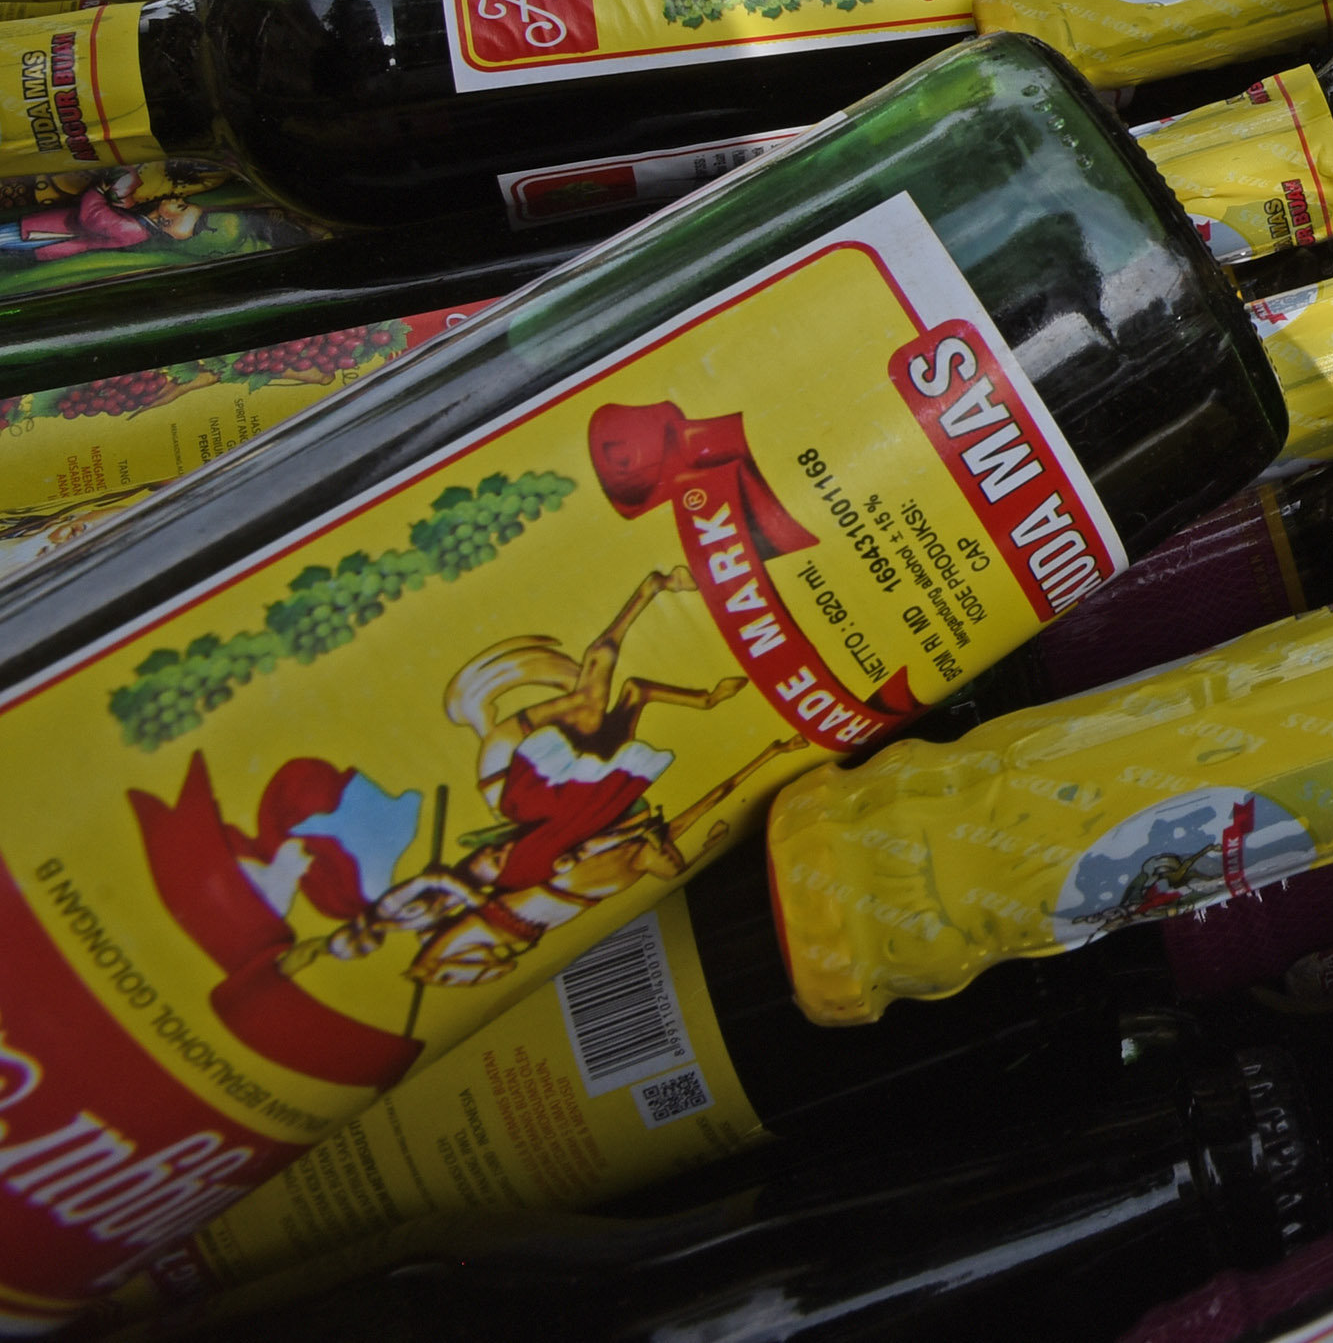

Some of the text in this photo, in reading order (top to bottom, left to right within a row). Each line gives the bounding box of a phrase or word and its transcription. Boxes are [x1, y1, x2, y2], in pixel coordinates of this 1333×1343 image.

[51, 31, 77, 88] BUAH
[22, 49, 63, 153] KUDA MAS
[1264, 197, 1291, 241] MAS
[1281, 179, 1315, 229] BUAH
[907, 336, 1045, 505] MAS
[56, 473, 70, 499] ANAK
[796, 446, 903, 594] 169431001168
[863, 493, 972, 649] Mengandung alkohol 15 %
[901, 497, 989, 625] KODE PRODUKSI:
[956, 536, 992, 572] CAP
[797, 558, 891, 685] NETTO 620 ml.
[902, 604, 934, 636] MD
[921, 631, 944, 652] RI
[775, 665, 884, 746] TRADE
[33, 856, 277, 1110] BERALKOHOL GOLONGAN B
